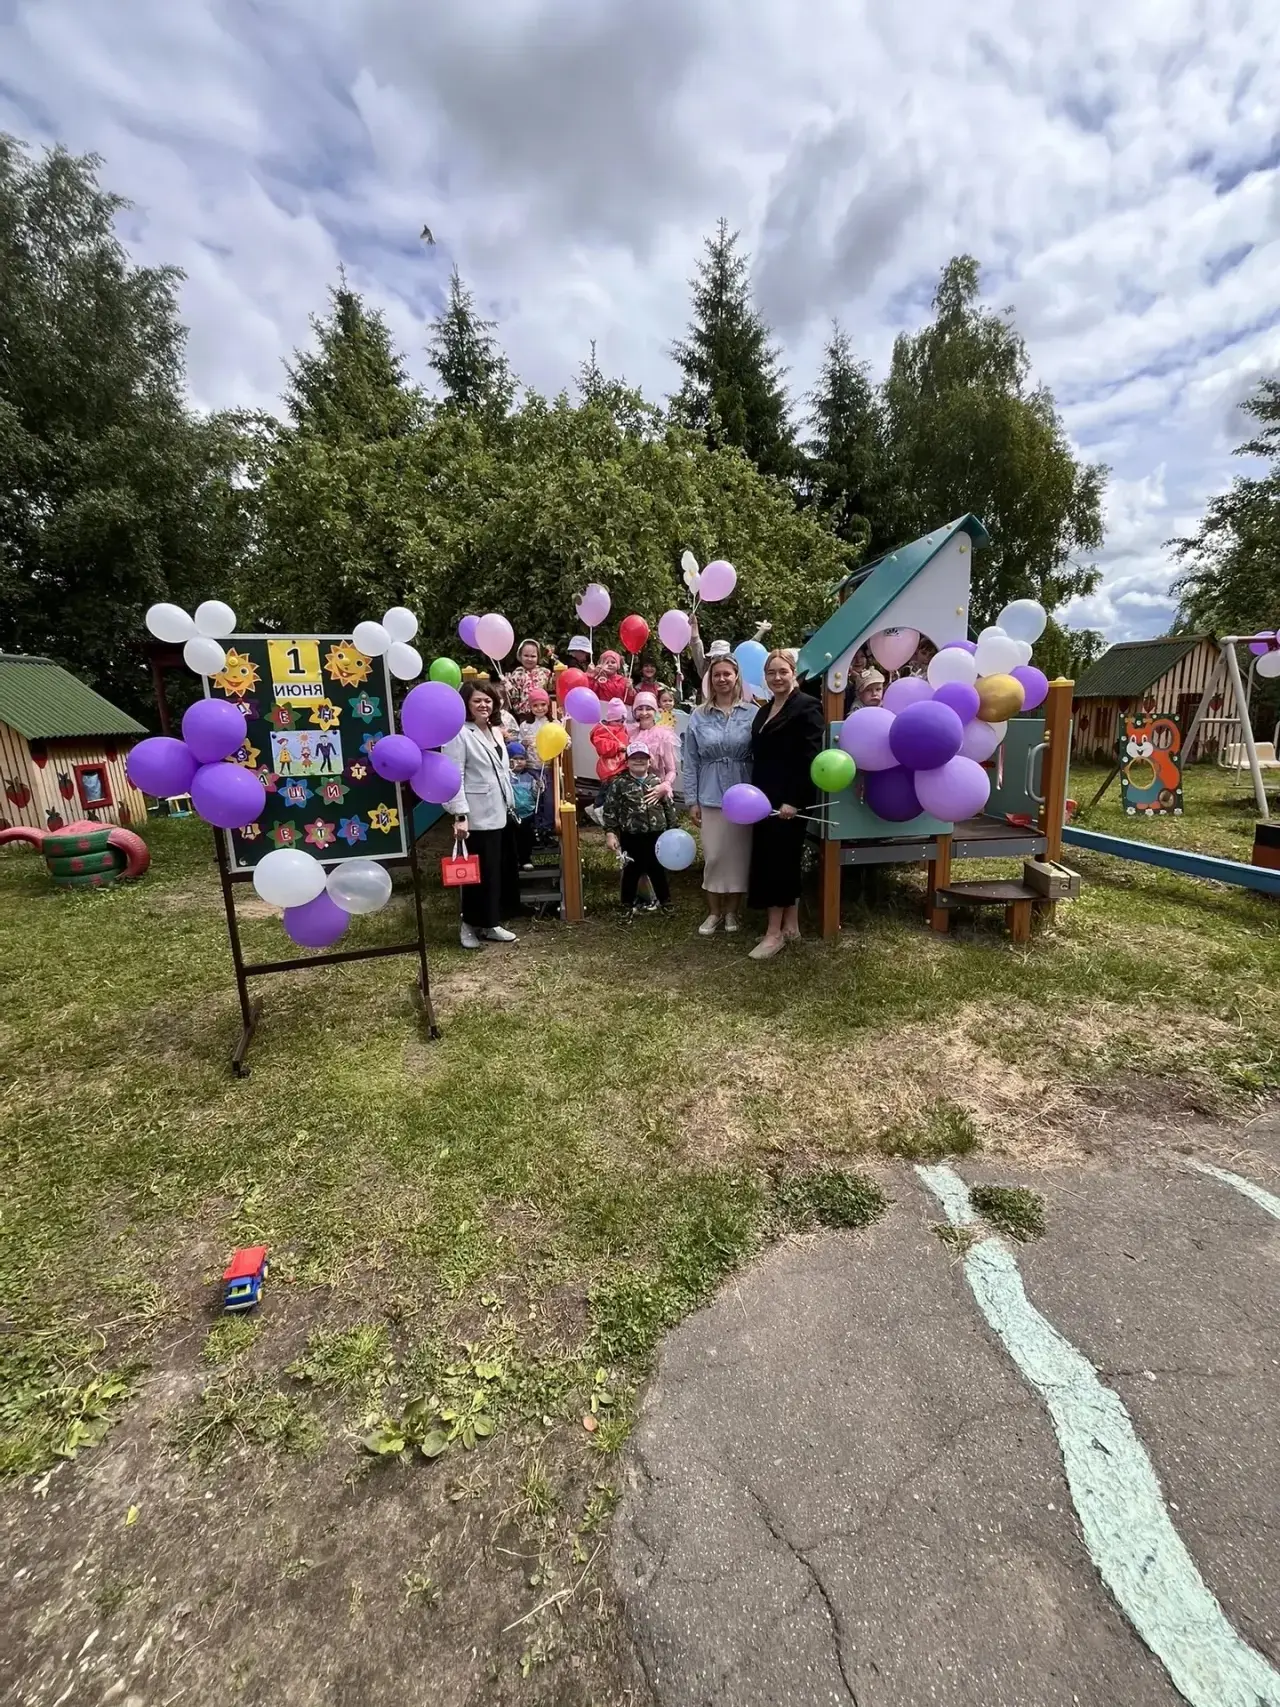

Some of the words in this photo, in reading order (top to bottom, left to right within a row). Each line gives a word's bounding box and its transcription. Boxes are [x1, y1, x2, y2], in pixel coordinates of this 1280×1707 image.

[286, 648, 306, 674] 1
[274, 684, 323, 697] ИЮНЯ
[244, 809, 389, 842] ДЕТЕЙ
